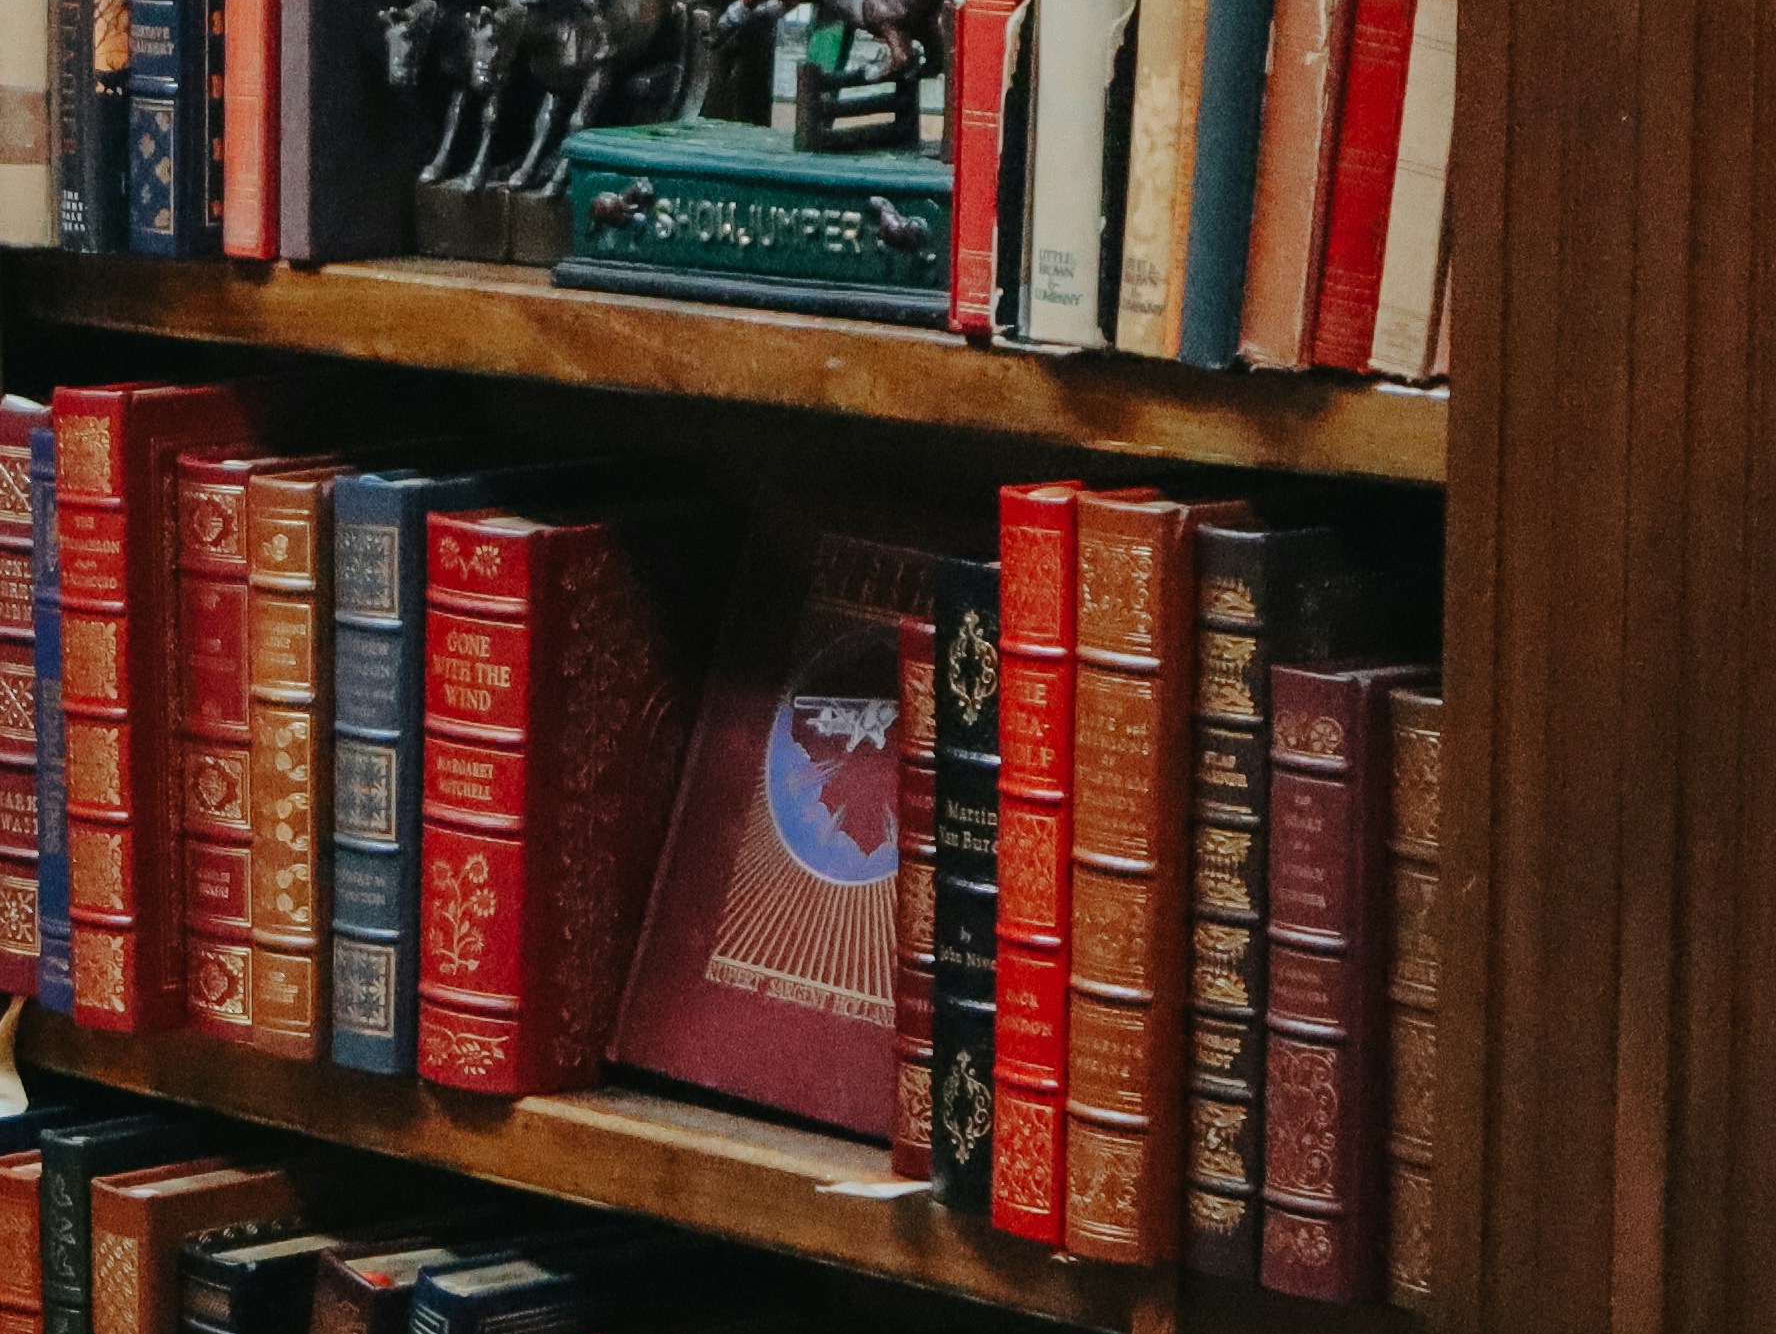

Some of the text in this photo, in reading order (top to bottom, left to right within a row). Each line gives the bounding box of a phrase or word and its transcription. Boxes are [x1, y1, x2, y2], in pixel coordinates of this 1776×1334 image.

[446, 629, 492, 659] GONE
[432, 653, 512, 689] WITH THE
[443, 683, 493, 712] WIND
